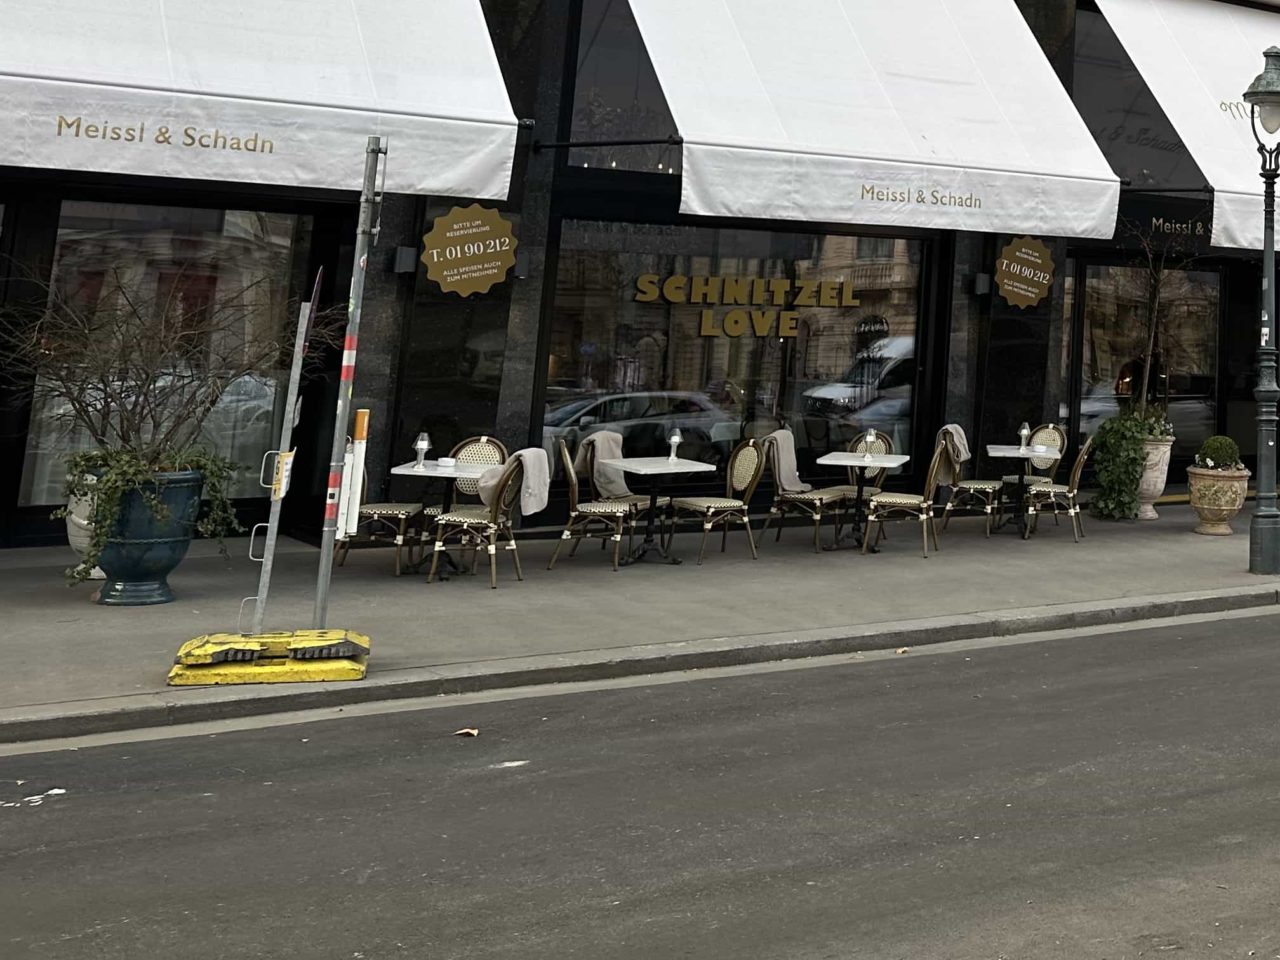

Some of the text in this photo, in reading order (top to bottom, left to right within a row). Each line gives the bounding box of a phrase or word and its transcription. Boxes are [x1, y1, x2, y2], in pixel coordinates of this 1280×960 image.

[56, 115, 274, 154] Meissl & Schadn
[861, 184, 982, 208] Meissl & Schadn
[446, 225, 490, 237] RESERVIERUNG
[453, 221, 470, 230] BITTE
[1152, 217, 1191, 234] Meissl
[1195, 222, 1204, 236] &
[429, 237, 510, 262] T. 01 90 212
[443, 261, 501, 276] ALLE SPEISEN AUCH
[447, 268, 498, 282] ZUM MITNEHMEN
[1002, 259, 1050, 284] T. 01 90 212
[634, 273, 861, 307] SCHNITZEL
[700, 308, 800, 338] LOVE
